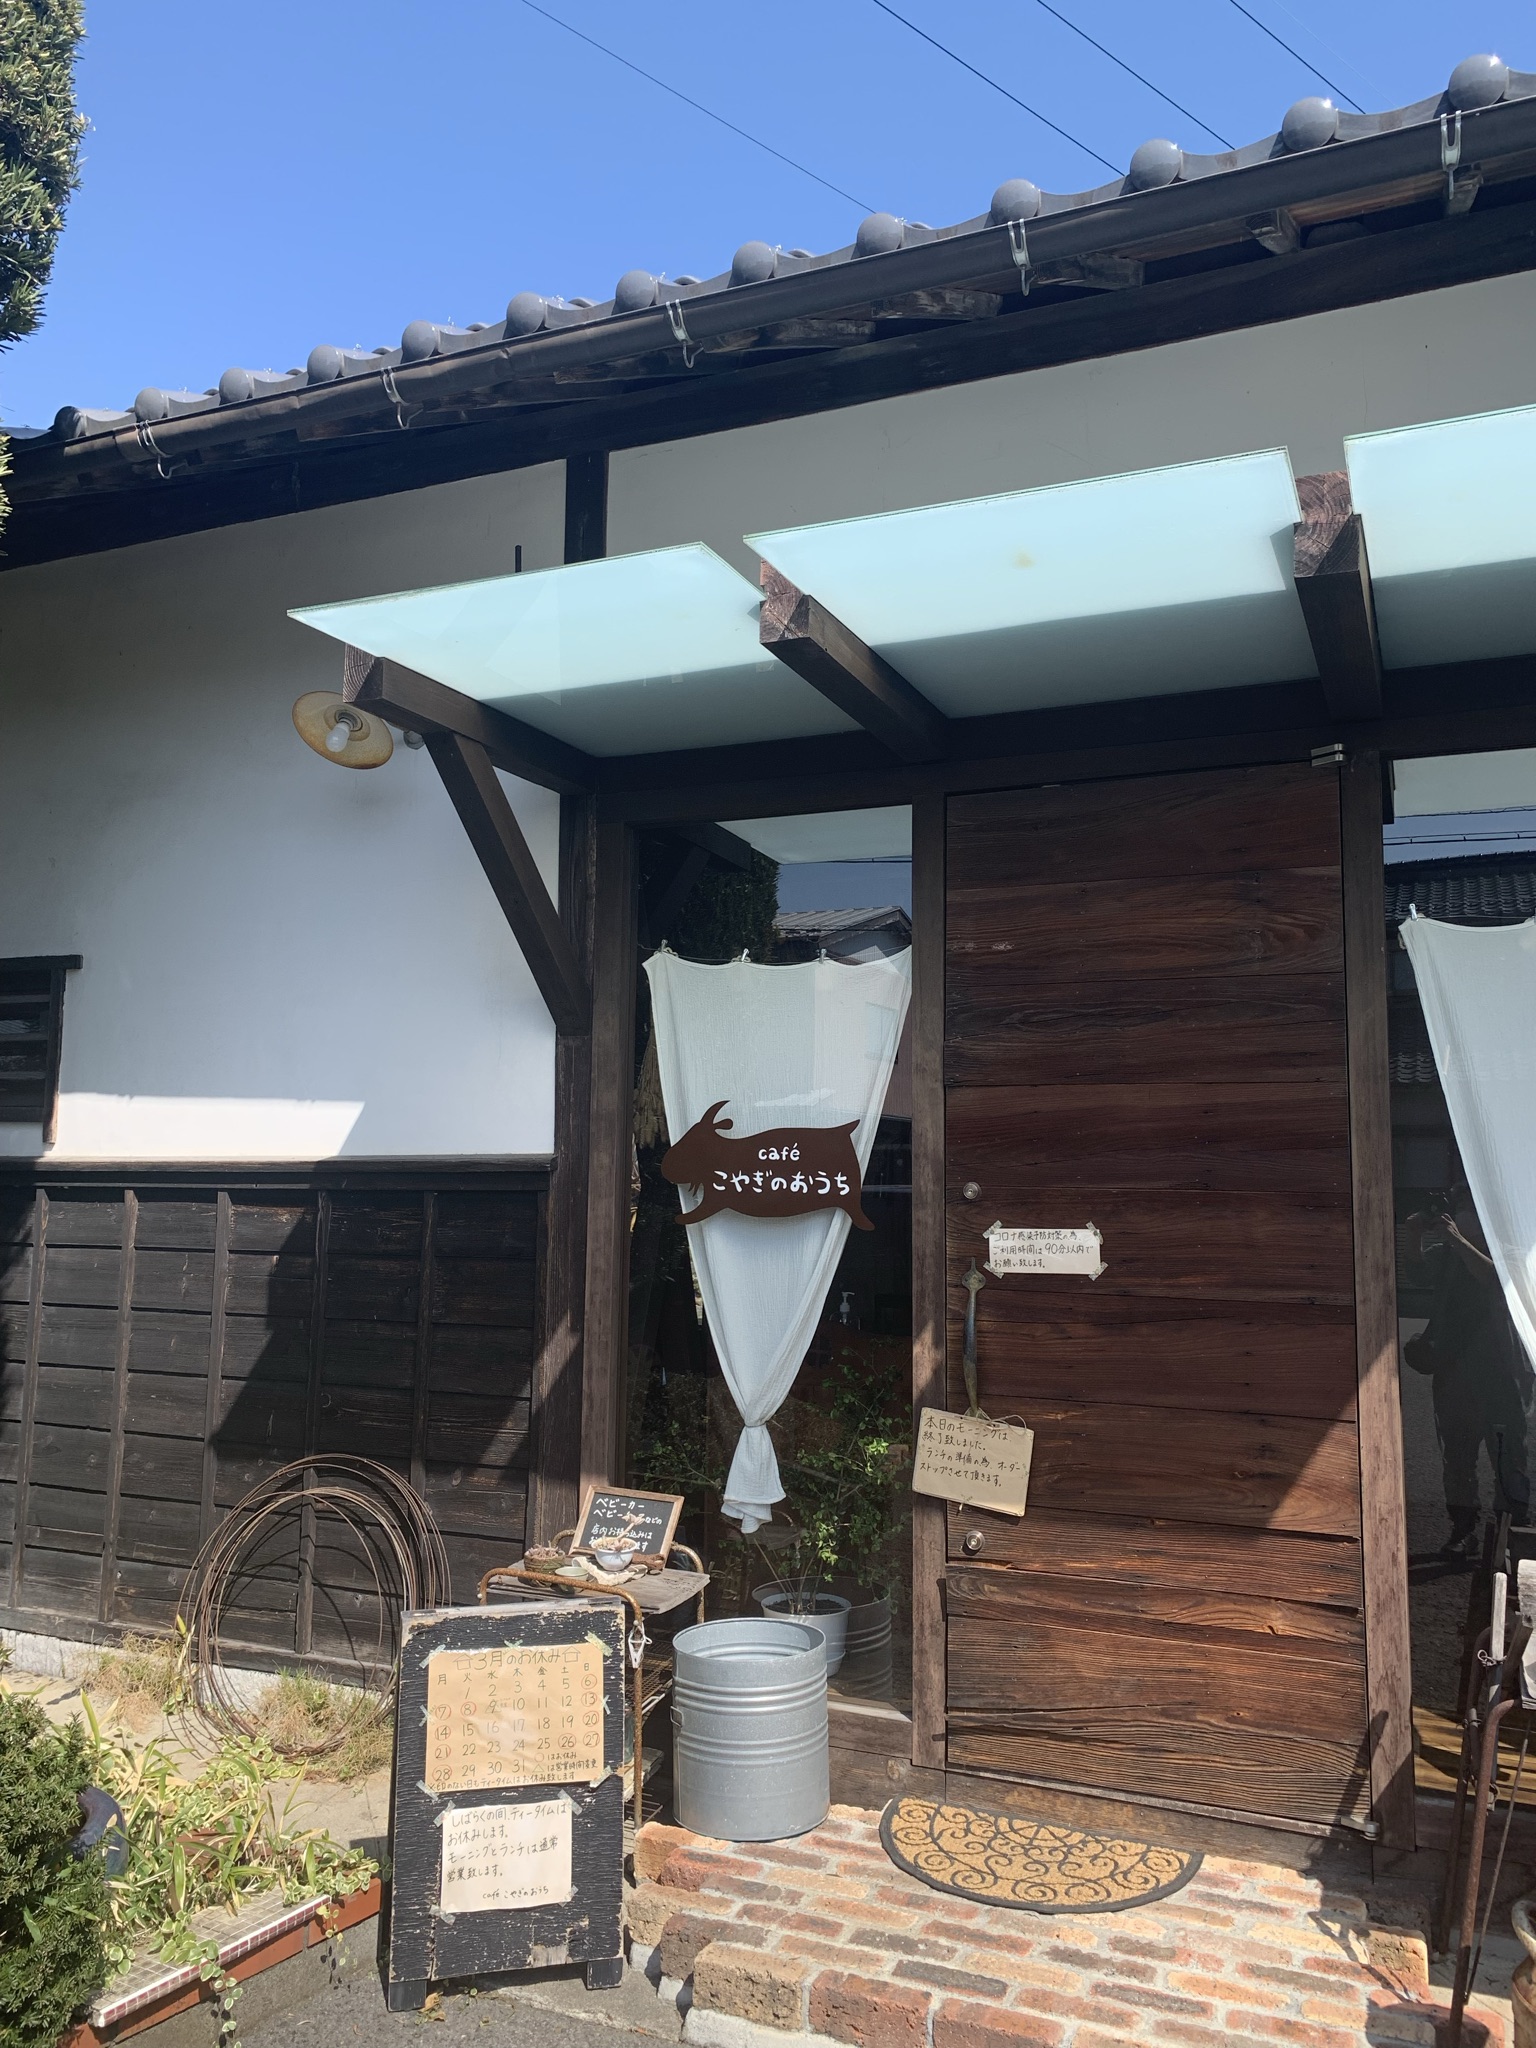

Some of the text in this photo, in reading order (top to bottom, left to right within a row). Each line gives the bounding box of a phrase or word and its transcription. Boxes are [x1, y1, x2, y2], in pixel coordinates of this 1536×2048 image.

[758, 1143, 801, 1161] café
[712, 1169, 851, 1196] こやぎのおうち
[993, 1259, 1046, 1269] お願い致します。
[922, 1430, 986, 1451] 終了致しました。
[920, 1462, 1002, 1488] ストップさせて頂きます。
[595, 1498, 645, 1510] ベビーカー
[473, 1650, 561, 1671] 3月のお休み
[437, 1674, 447, 1685] 月
[463, 1674, 472, 1682] 火
[487, 1670, 498, 1679] 水
[513, 1668, 523, 1677] 木
[537, 1666, 547, 1676] 金
[584, 1663, 590, 1671] 日
[465, 1676, 592, 1699] 1 2 3 4 5 6
[438, 1706, 446, 1718] 7
[463, 1704, 472, 1715] 8
[489, 1700, 497, 1714] 9
[512, 1697, 525, 1711] 10
[537, 1697, 548, 1708] 11
[561, 1696, 572, 1707] 12
[584, 1694, 596, 1705] 13
[437, 1713, 598, 1738] 14 15 16 17 18 19 20
[436, 1733, 599, 1759] 21 22 23 24 25 26 27
[435, 1759, 525, 1781] 28 29 30 31
[447, 1824, 509, 1847] お休みします。
[448, 1835, 559, 1864] モーニングとランチは通常
[446, 1864, 504, 1883] 営業致します。
[503, 1885, 550, 1899] こやぎのおうち
